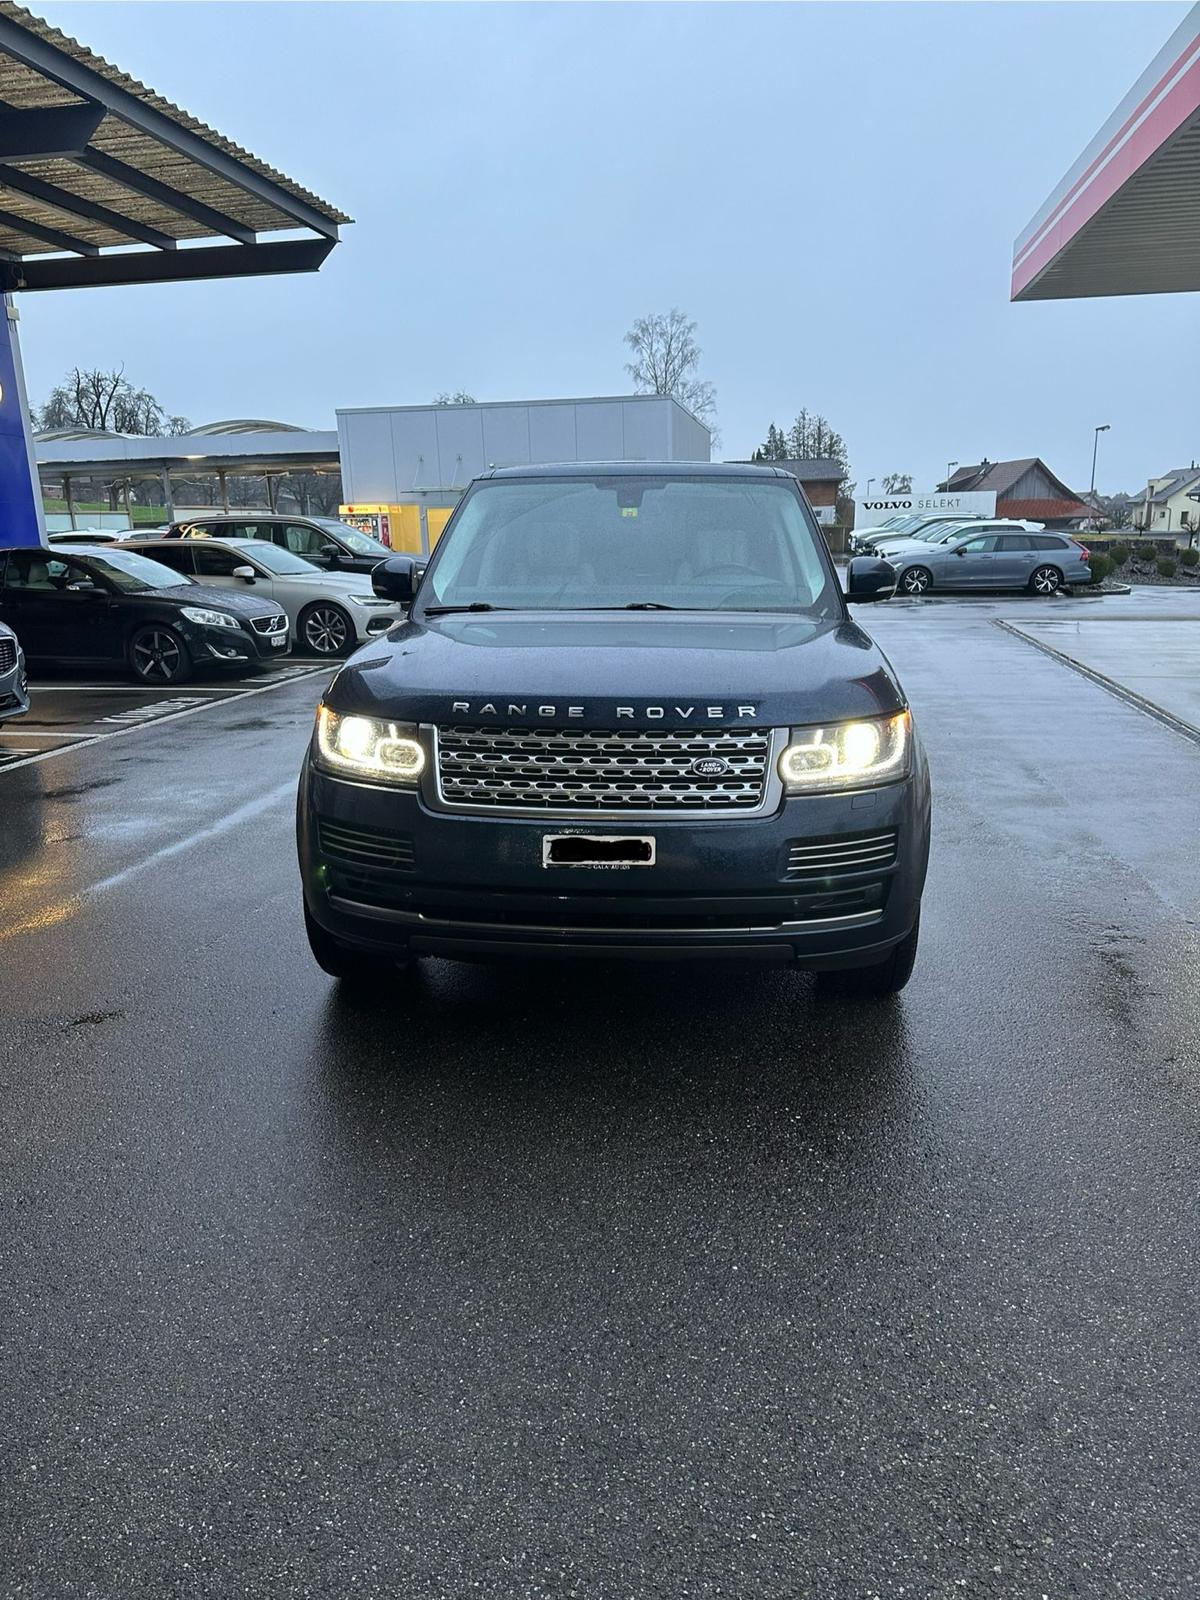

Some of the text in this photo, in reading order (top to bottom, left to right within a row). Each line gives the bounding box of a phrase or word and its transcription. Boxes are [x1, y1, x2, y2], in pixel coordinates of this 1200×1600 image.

[862, 498, 961, 510] VOLVO SELEKT
[451, 701, 757, 718] RANGE ROVER
